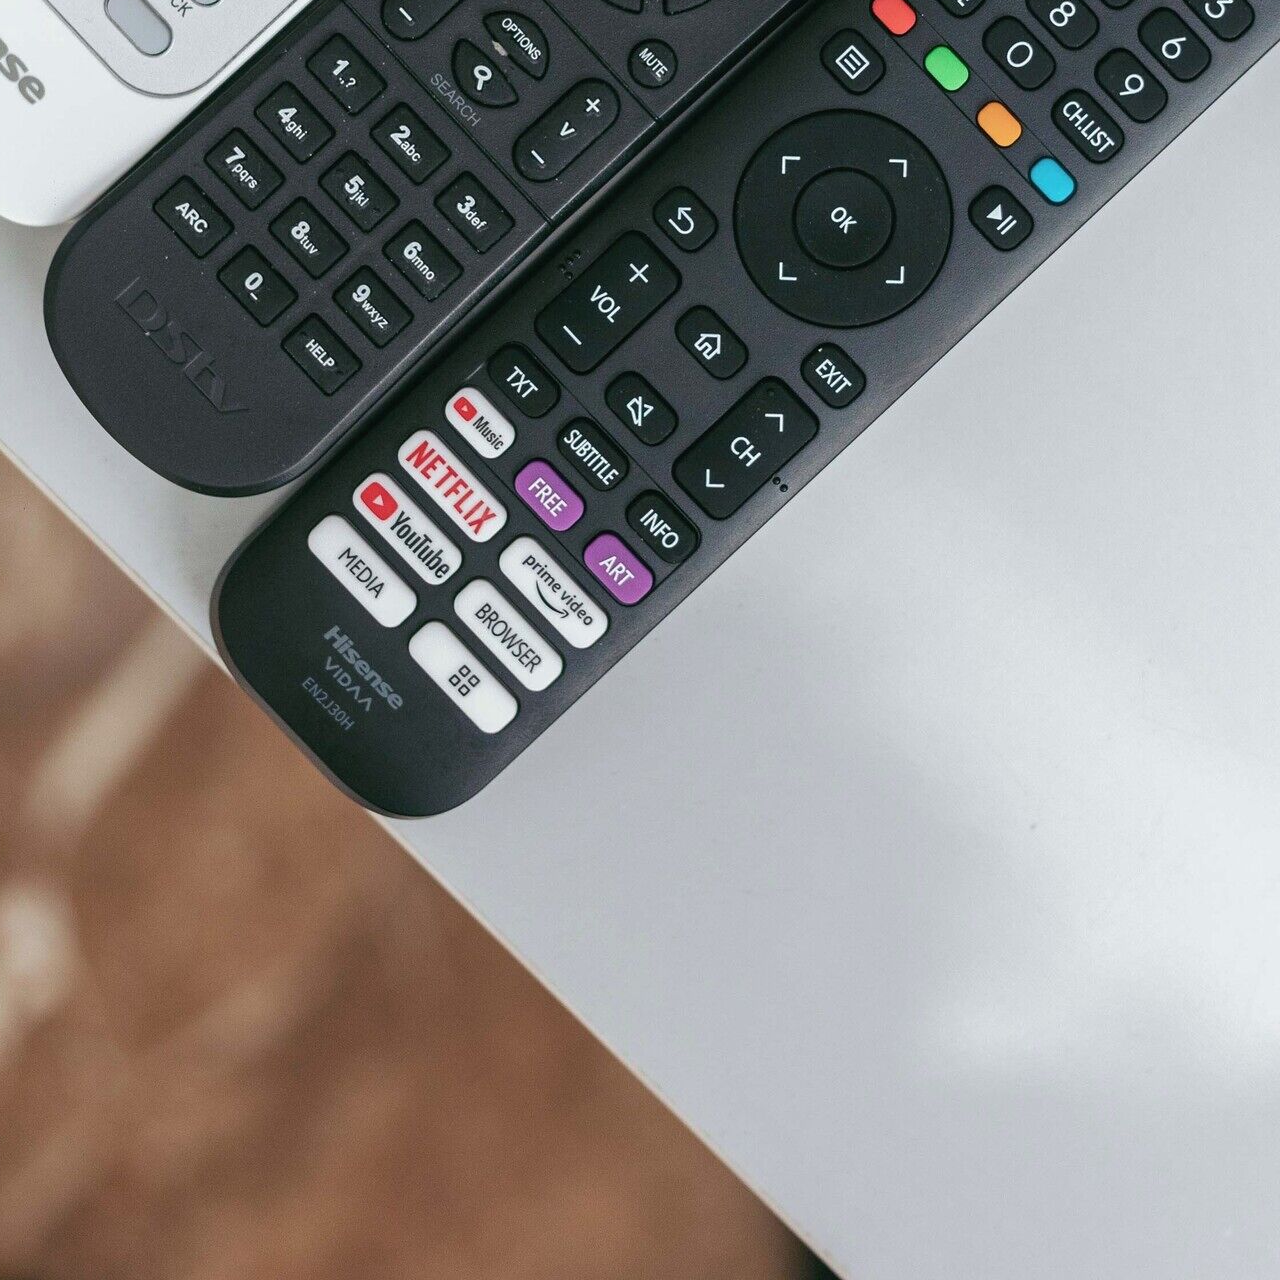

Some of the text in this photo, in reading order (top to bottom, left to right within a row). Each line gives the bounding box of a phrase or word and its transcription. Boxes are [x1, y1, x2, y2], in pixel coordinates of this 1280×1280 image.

[1050, 1, 1076, 28] 8
[502, 18, 541, 61] OPTIONS
[1006, 41, 1033, 68] 0
[1161, 36, 1187, 60] 6
[639, 47, 668, 78] MUTE
[430, 72, 481, 127] SEARCH
[1120, 73, 1145, 97] 9
[1062, 101, 1115, 154] CH.LIST
[175, 202, 208, 234] ARC
[830, 207, 857, 234] OK
[591, 286, 621, 323] VOL
[306, 339, 334, 369] HELP
[506, 367, 538, 399] TXT
[815, 359, 851, 395] EXIT
[473, 415, 504, 452] Music
[730, 436, 762, 467] CH
[564, 429, 619, 486] SUBTITLE
[406, 440, 497, 536] NETFLIX
[528, 477, 567, 518] FREE
[389, 511, 451, 580] YouTube
[640, 508, 680, 549] INFO
[338, 547, 385, 599] MEDIA
[600, 554, 635, 588] ART
[522, 554, 593, 626] prime video
[475, 603, 543, 674] BROWSER
[323, 624, 404, 711] Hisense
[301, 676, 355, 731] EN2J30H
